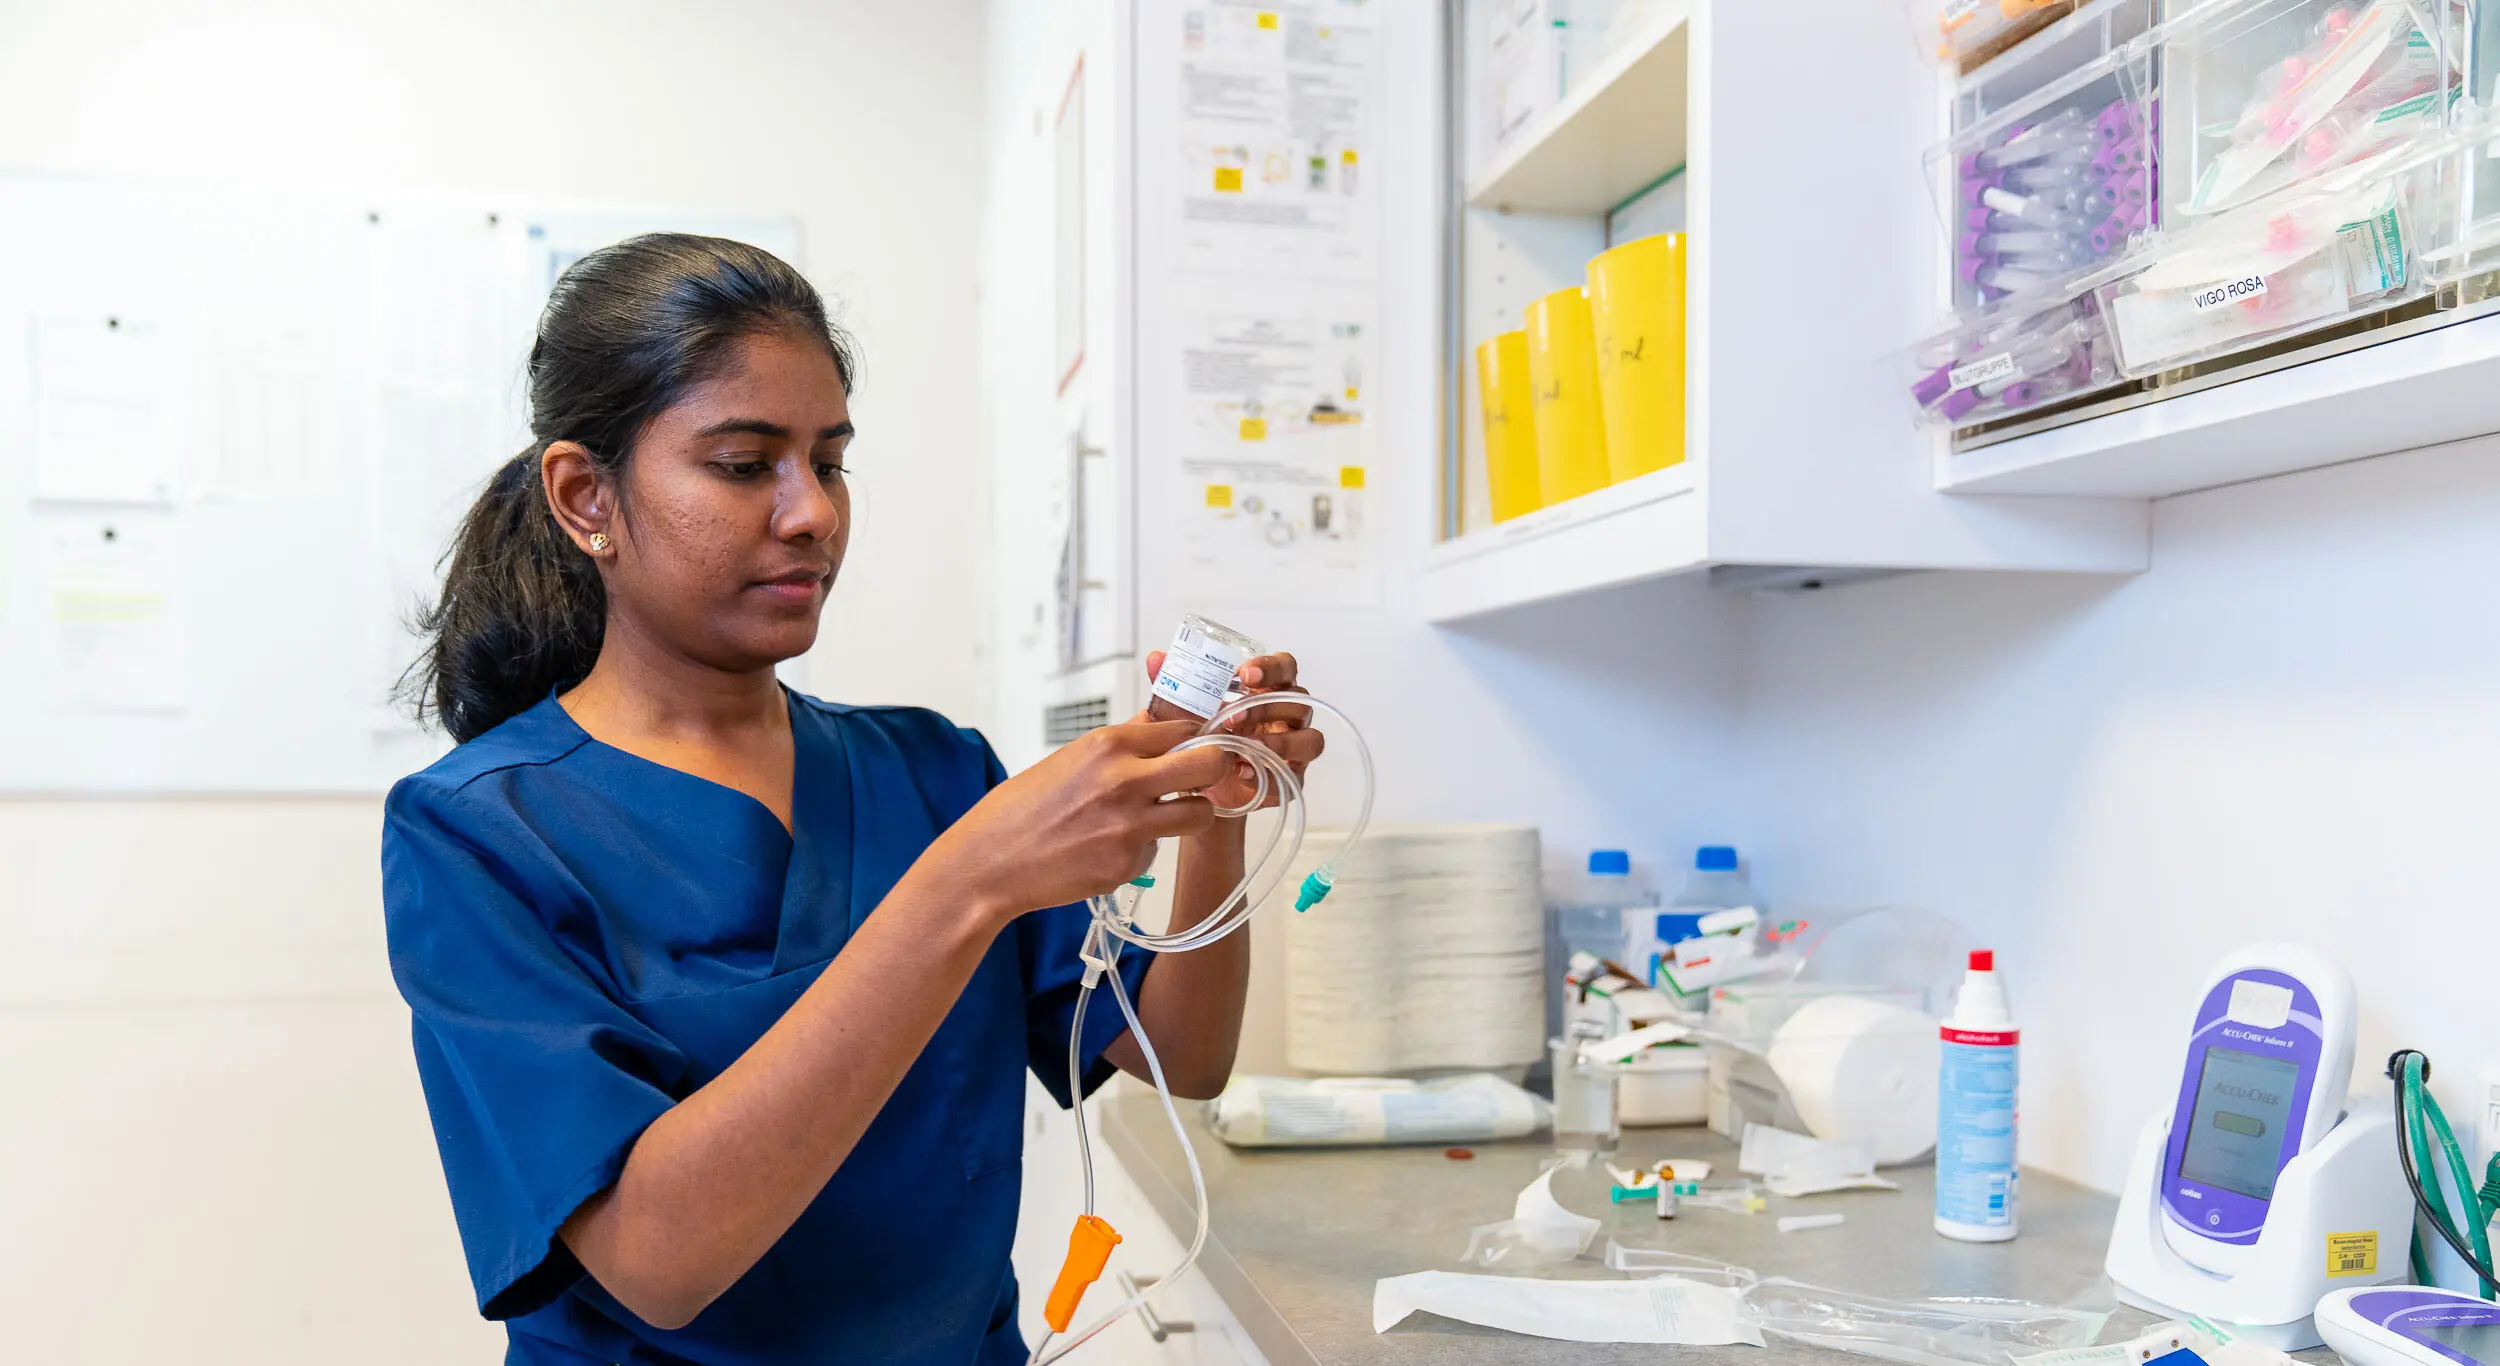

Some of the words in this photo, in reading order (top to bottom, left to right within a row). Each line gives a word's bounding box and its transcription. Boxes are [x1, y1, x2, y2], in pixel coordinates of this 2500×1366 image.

[2194, 288, 2226, 308] VIGO
[2228, 275, 2264, 298] ROSA
[2214, 1081, 2279, 1106] ACCU-CHEK
